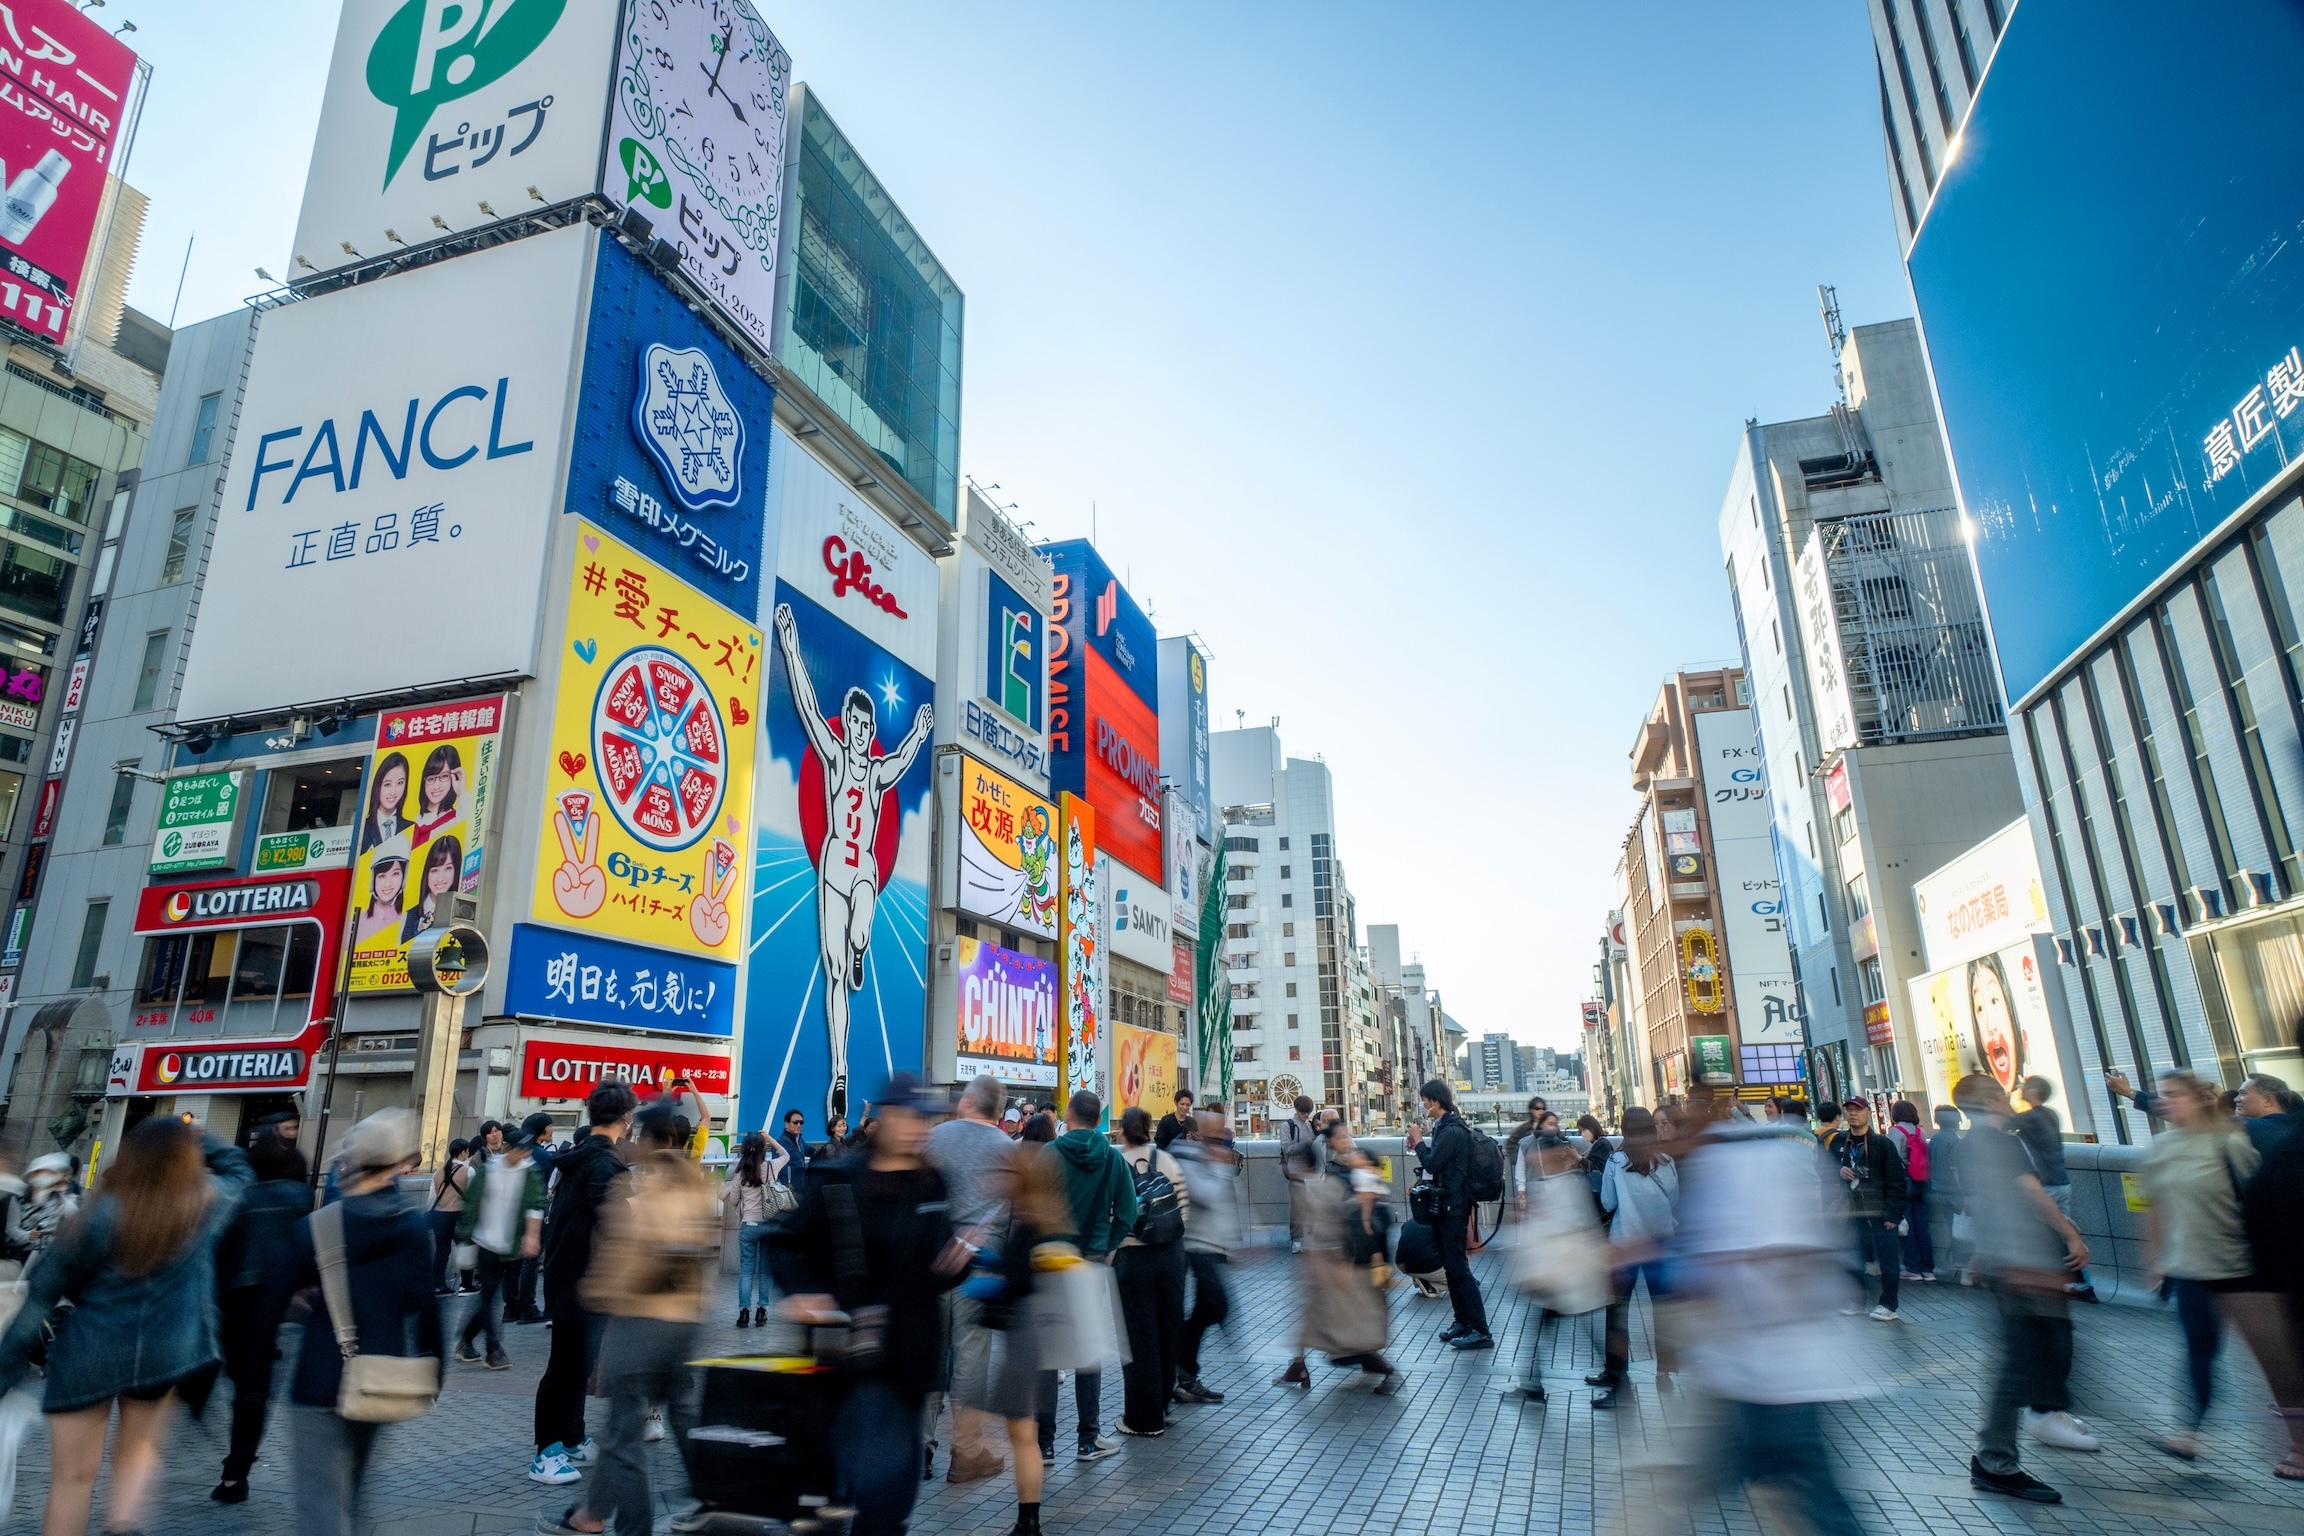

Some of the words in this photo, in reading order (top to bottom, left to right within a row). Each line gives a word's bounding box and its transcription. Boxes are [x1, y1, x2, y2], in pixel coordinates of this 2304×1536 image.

[655, 47, 674, 72] 8
[31, 69, 112, 135] HAIR
[675, 98, 694, 119] 7
[751, 90, 767, 112] 2
[423, 94, 554, 182] ピップ
[701, 136, 715, 164] 6
[754, 127, 771, 149] 3
[728, 155, 741, 183] 5
[747, 151, 760, 178] 4
[678, 193, 742, 276] ピップ
[8, 254, 52, 291] 検索
[676, 240, 708, 283] Oct.
[709, 271, 729, 307] 31,
[731, 297, 766, 339] 2023
[246, 376, 535, 512] FANCL
[285, 502, 462, 569] 正直品質。
[613, 473, 749, 582] 雪印メグミルク
[983, 532, 1042, 599] エステムシリーズ
[611, 671, 637, 711] SNOW
[656, 666, 687, 690] SNOW
[408, 706, 496, 738] 住宅情報館
[700, 710, 718, 754] SNOW
[55, 720, 72, 772] NYNY
[1098, 715, 1160, 805] PROMISE
[605, 743, 626, 791] SNOW
[179, 794, 203, 807] 足つぼ
[183, 778, 219, 791] もみほぐし
[471, 739, 494, 849] 住まいの専門ショップ
[567, 797, 587, 806] SNOW
[691, 782, 713, 821] SNOW
[976, 773, 1011, 809] かぜに
[175, 809, 215, 822] アロマオイル
[641, 811, 673, 832] SNOW
[845, 786, 865, 869] グリコ
[971, 795, 1015, 845] 改源
[1138, 797, 1160, 832] プロミス
[184, 840, 219, 850] ZUBORAYA
[270, 835, 299, 845] もみほぐし
[273, 845, 306, 864] ¥2,980
[465, 854, 479, 872] 探す
[195, 883, 308, 916] LOTTERIA
[1947, 883, 2010, 940] なの花薬局
[8, 911, 22, 949] FamilyMart
[1132, 903, 1168, 943] SAMTY
[545, 952, 716, 1018] 明日を、元気に!
[1759, 980, 1779, 988] NFT
[135, 1014, 148, 1027] 2F
[150, 1013, 168, 1025] 客席
[189, 1009, 215, 1024] 40席
[964, 960, 1056, 1051] CHINTAI
[184, 1052, 295, 1080] LOTTERIA
[1701, 1041, 1724, 1061] 薬
[536, 1058, 653, 1085] LOTTERIA
